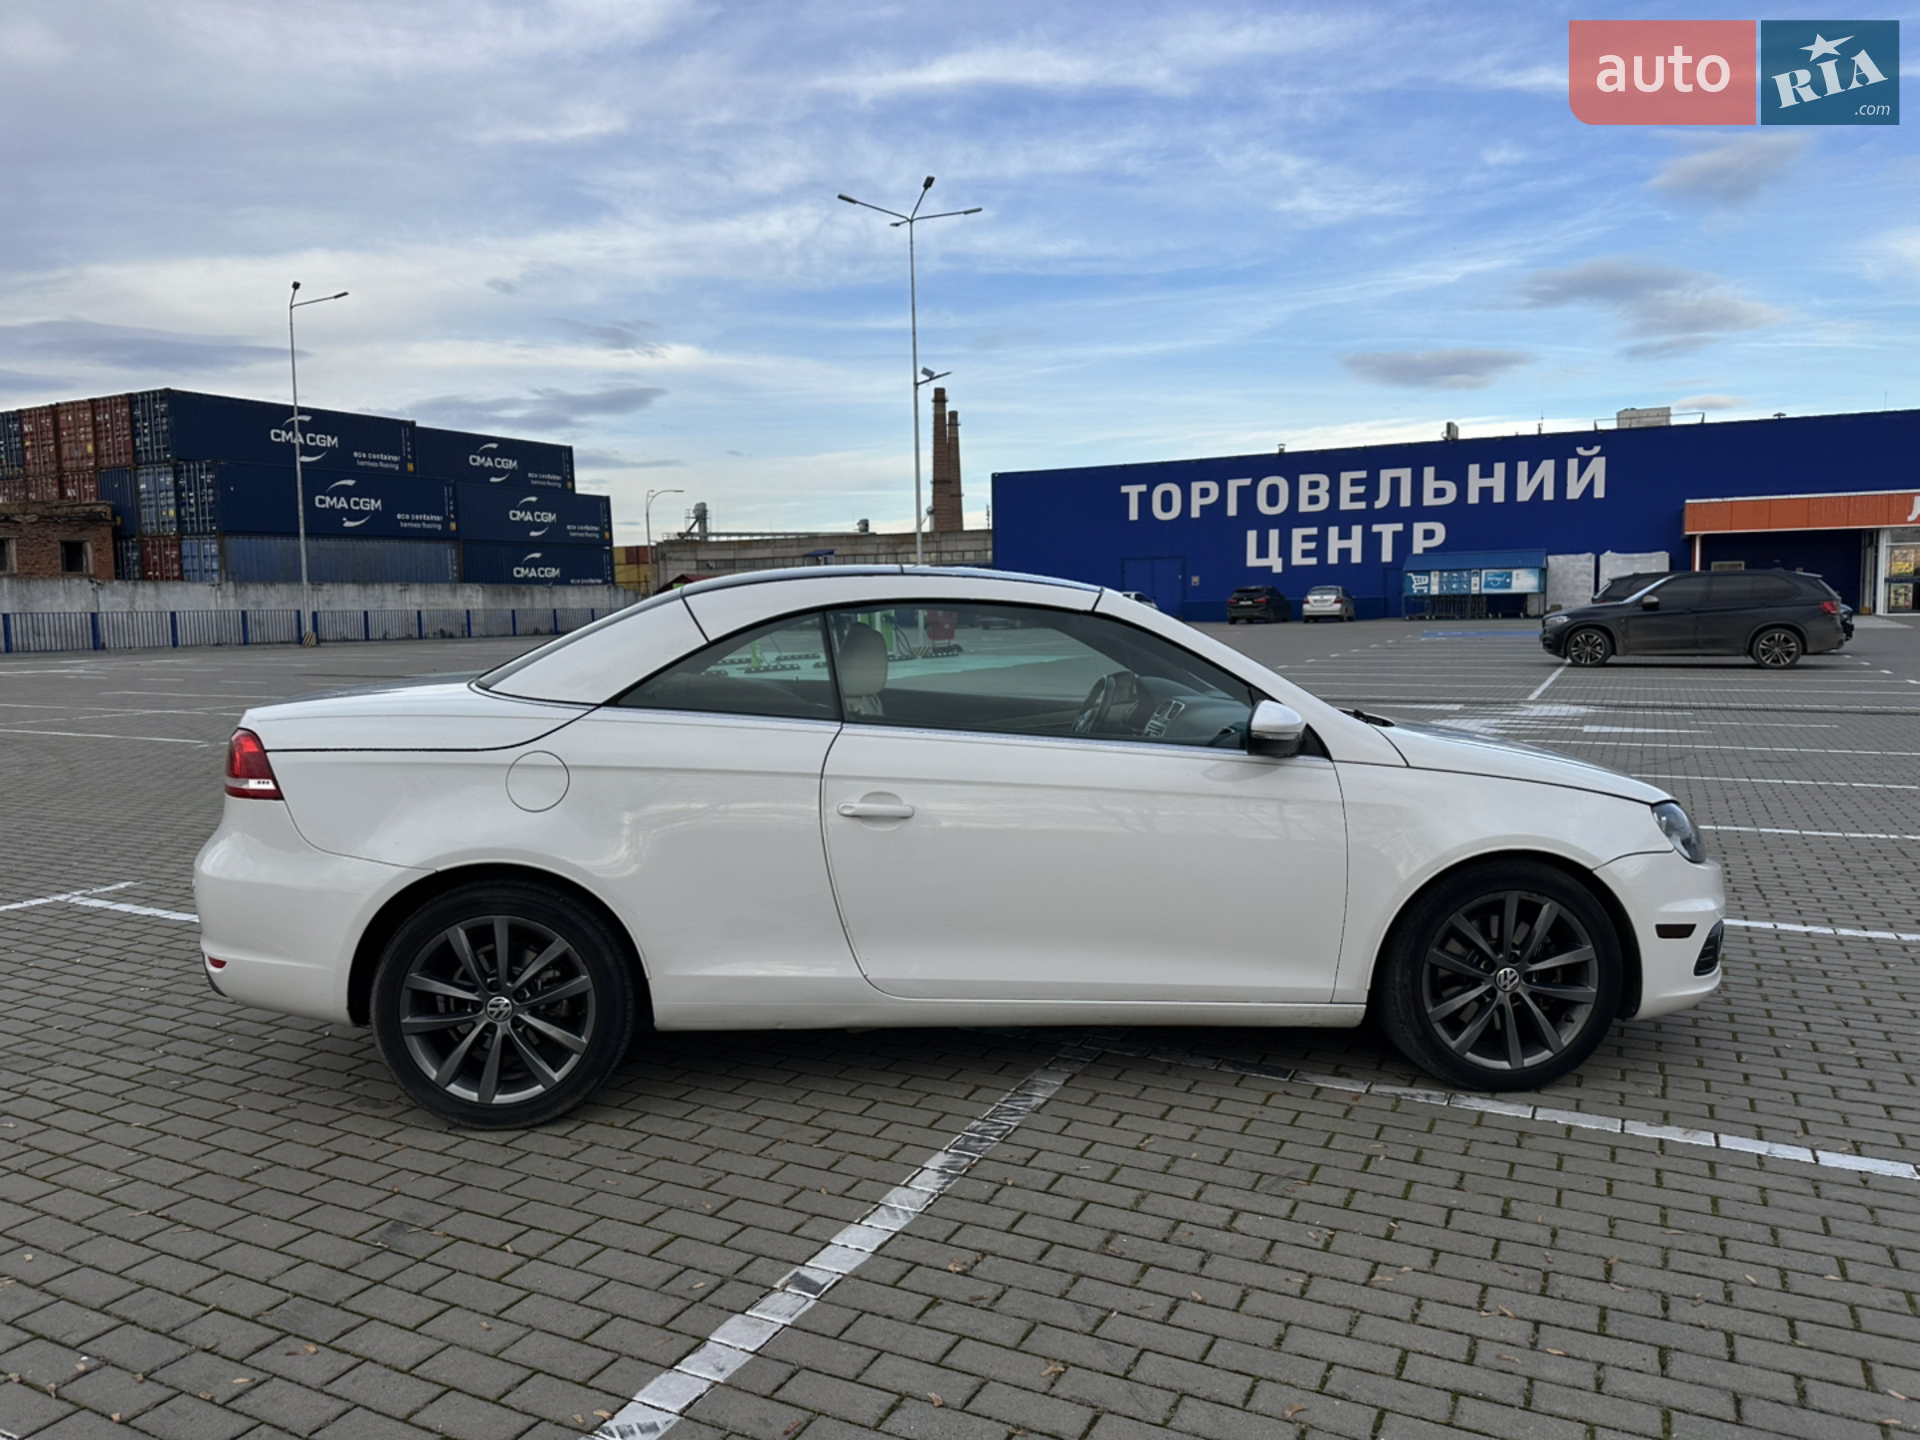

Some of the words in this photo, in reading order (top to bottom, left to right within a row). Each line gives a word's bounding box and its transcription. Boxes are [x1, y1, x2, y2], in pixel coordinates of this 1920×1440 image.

[270, 428, 305, 445] CMA
[306, 433, 339, 448] CGM
[469, 454, 494, 467] CMA
[494, 457, 518, 470] CGM
[1120, 445, 1607, 521] ТОРГОВЕЛЬНИЙ
[314, 495, 349, 509] CMA
[350, 497, 382, 511] CGM
[509, 510, 534, 522] CMA
[534, 511, 557, 523] CGM
[1246, 521, 1447, 573] ЦЕНТР
[513, 567, 537, 578] CMA
[537, 567, 560, 578] CGM
